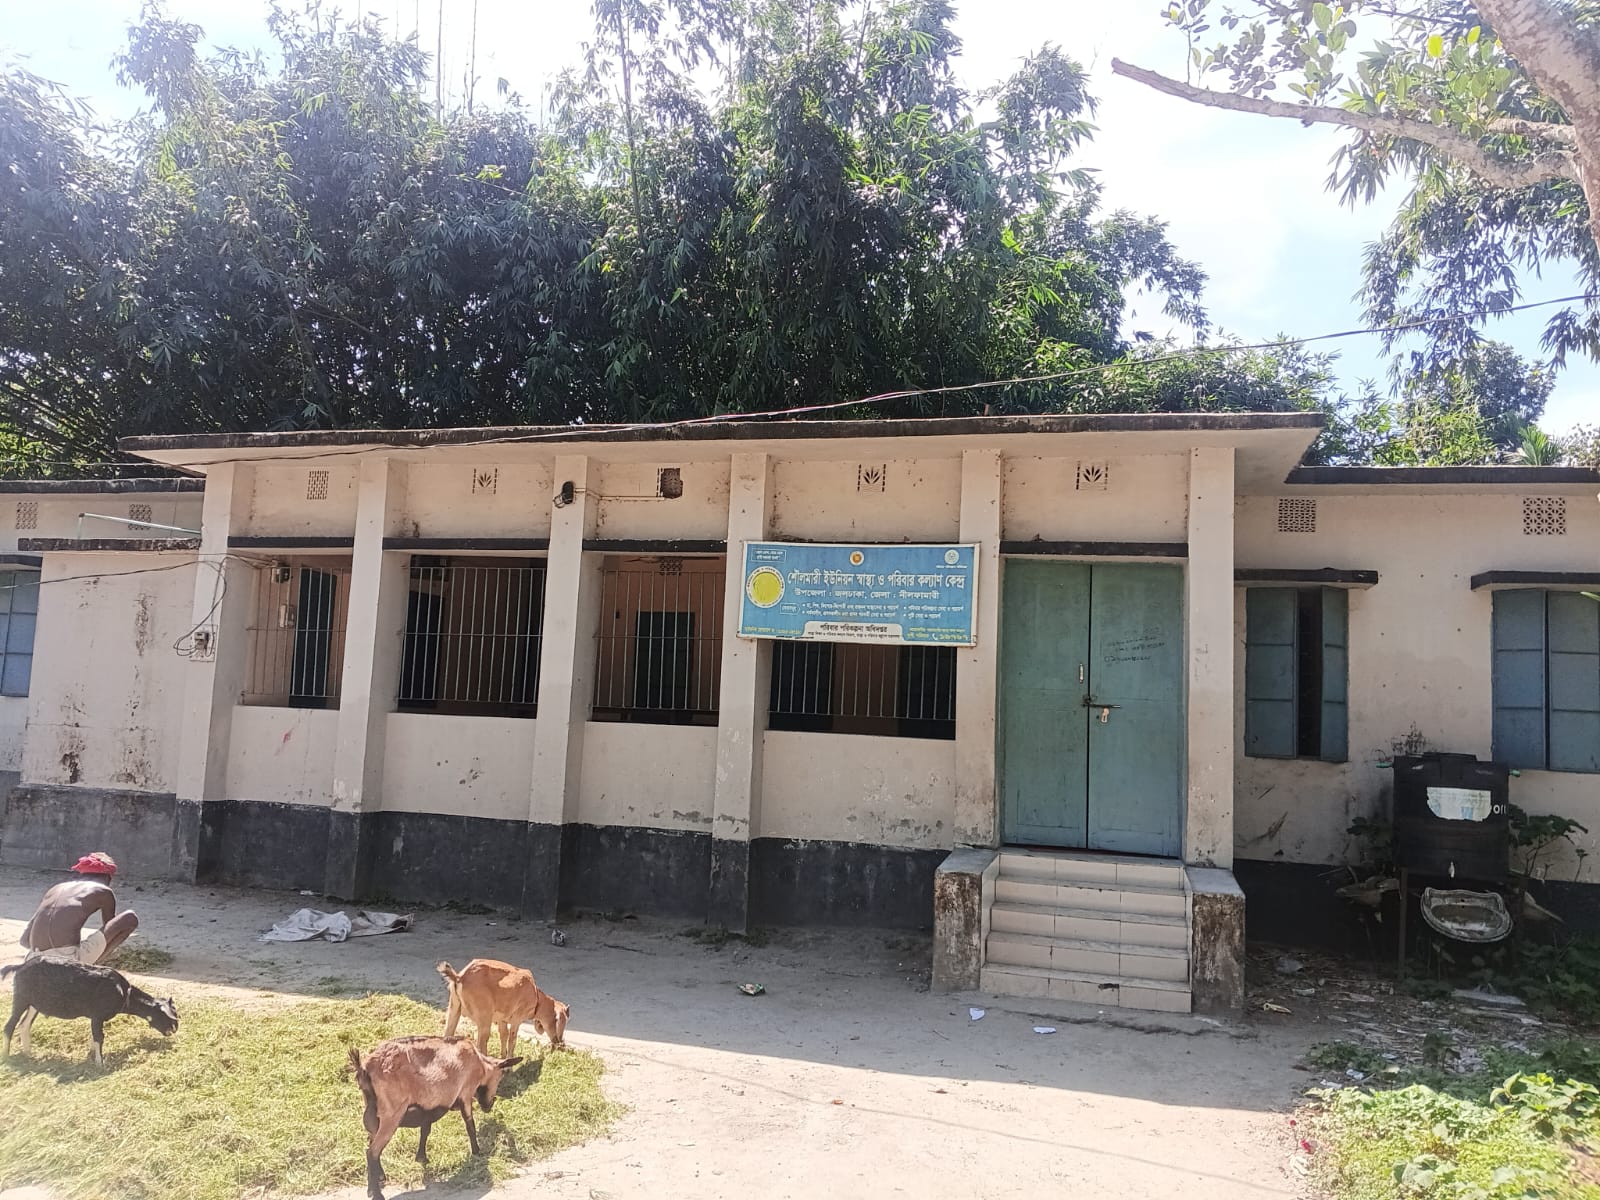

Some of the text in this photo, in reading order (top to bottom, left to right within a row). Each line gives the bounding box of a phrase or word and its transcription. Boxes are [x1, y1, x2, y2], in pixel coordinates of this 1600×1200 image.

[823, 569, 855, 586] ইউনিয়ন
[856, 573, 876, 589] স্বাস্থ্য
[878, 574, 885, 586] ও
[887, 570, 916, 587] পরিবার
[917, 573, 943, 588] কল্যাণ
[945, 574, 967, 590] কেন্দ্র
